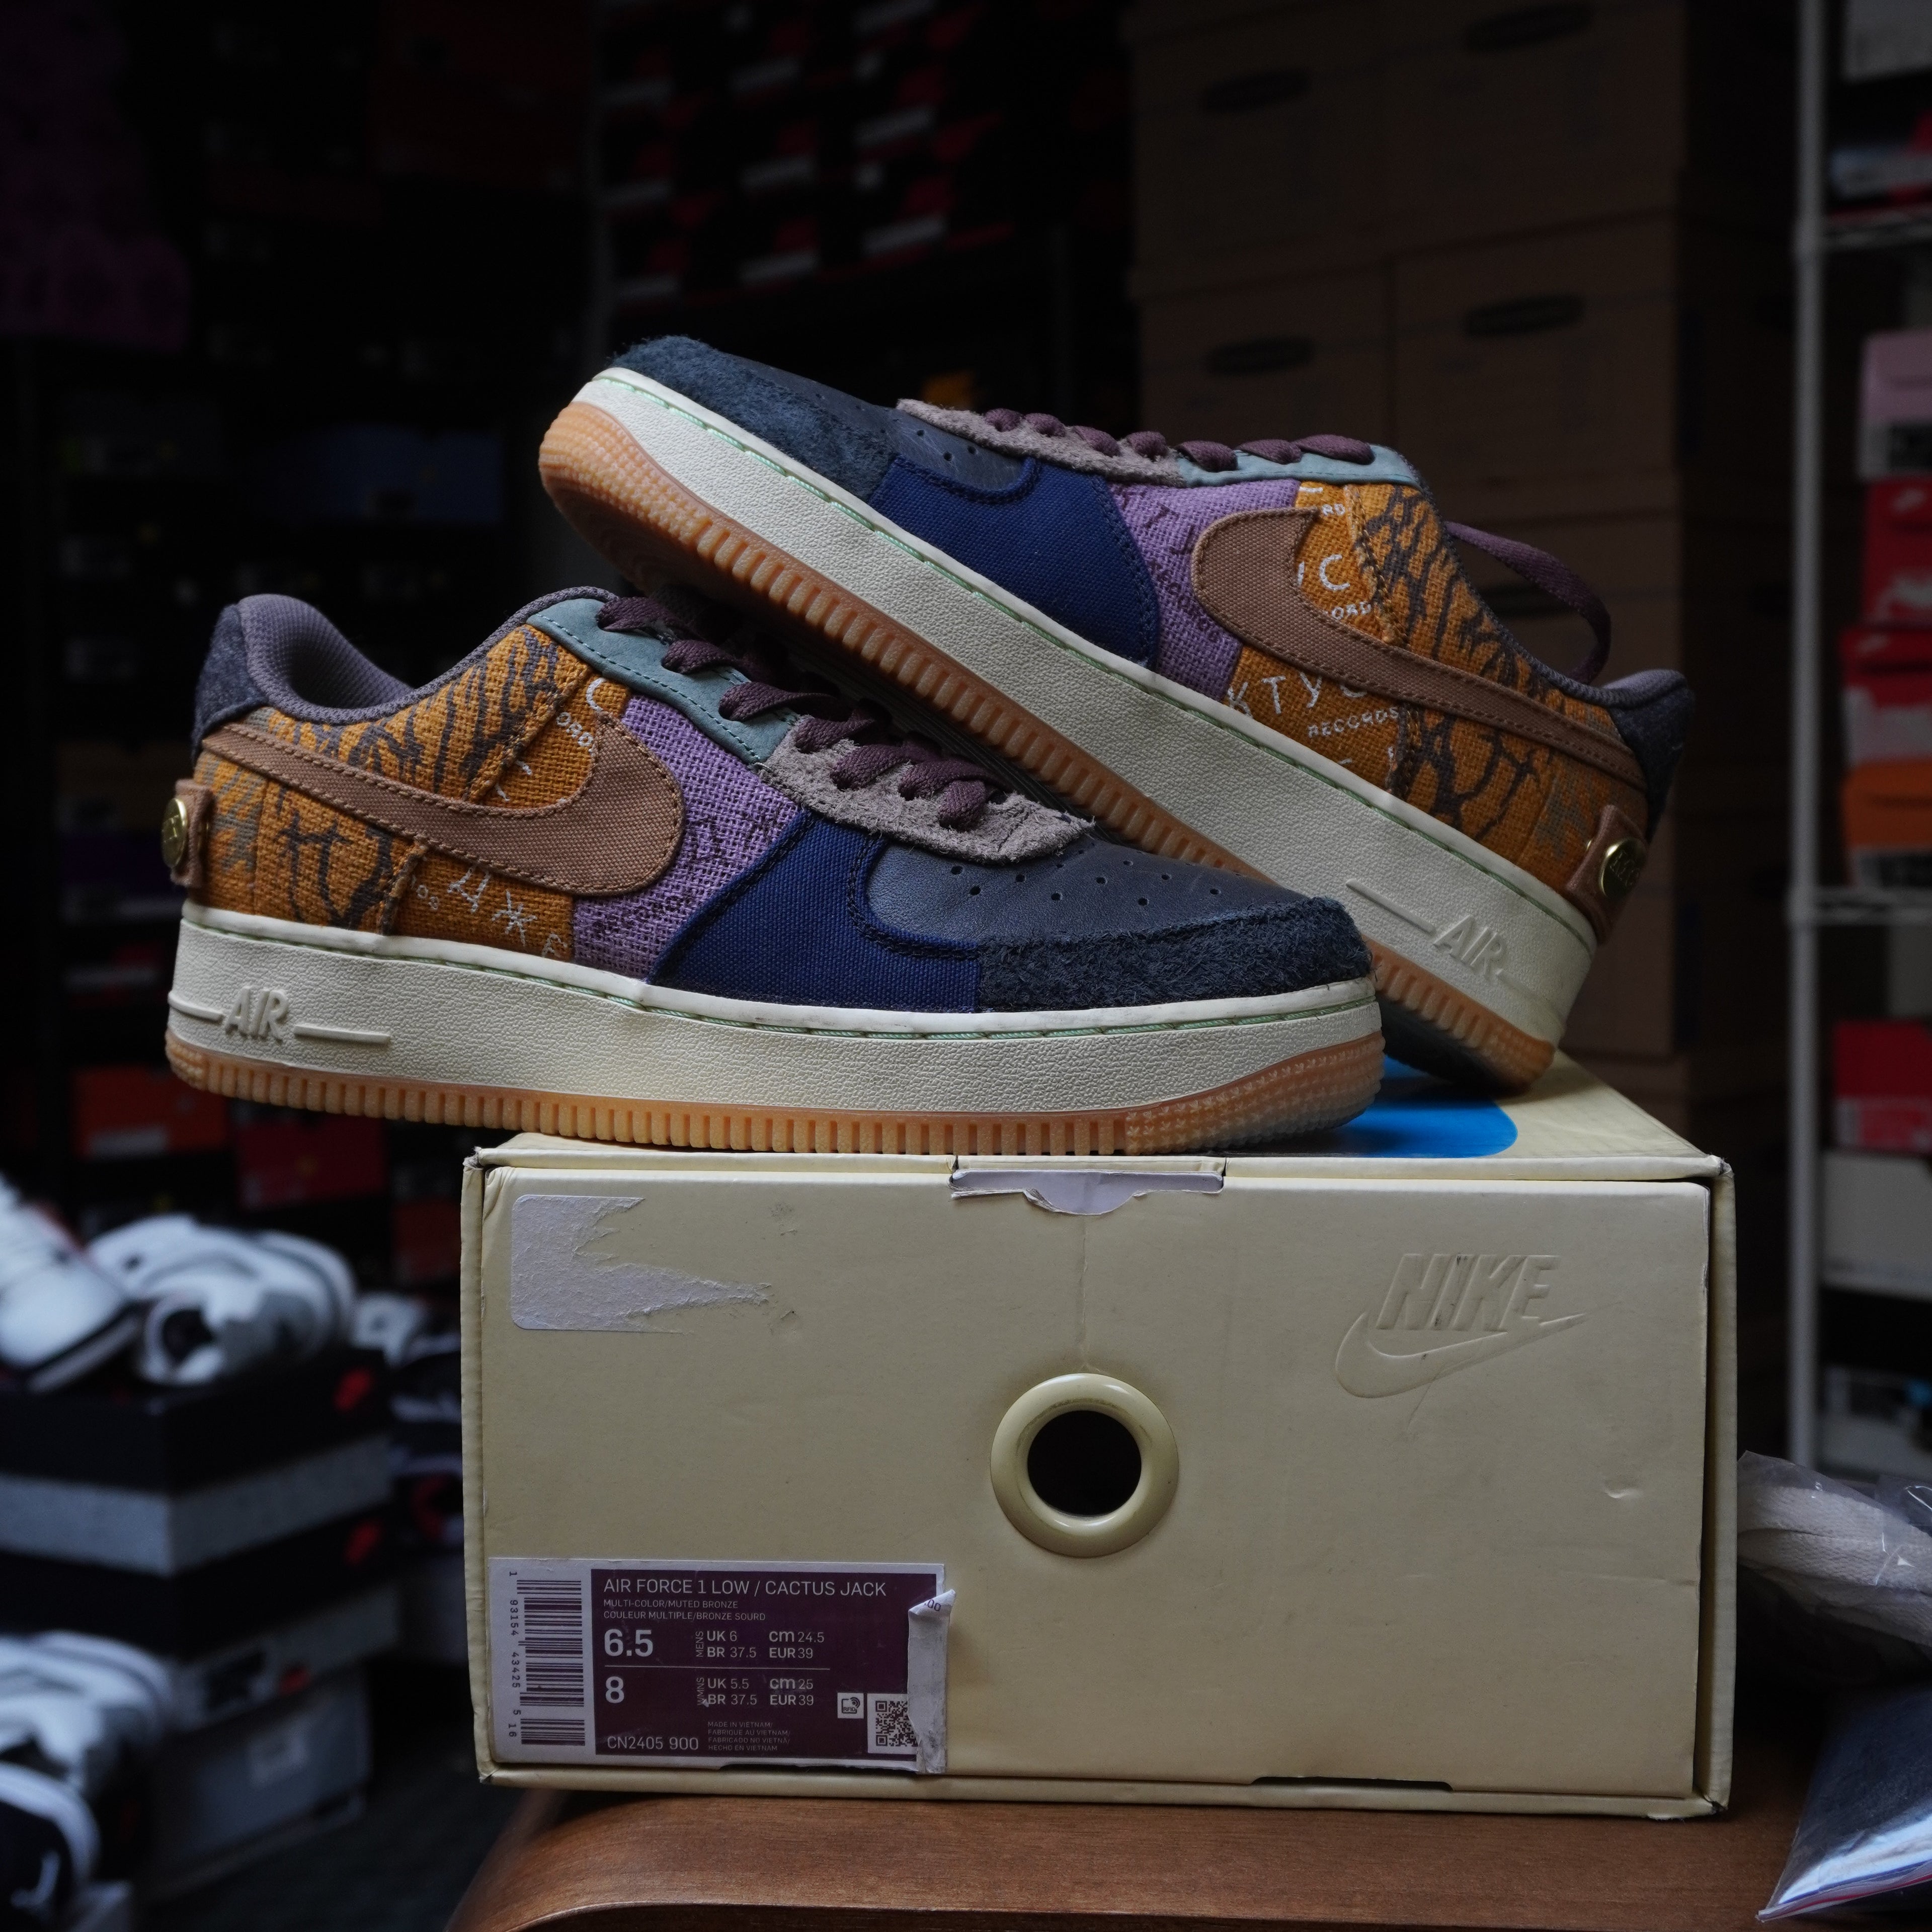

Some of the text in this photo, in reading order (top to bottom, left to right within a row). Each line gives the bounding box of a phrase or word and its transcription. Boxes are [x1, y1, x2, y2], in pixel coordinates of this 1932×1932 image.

[1433, 914, 1508, 981] AIR
[224, 985, 290, 1042] AIR
[1375, 1252, 1561, 1332] NIKE
[603, 1578, 887, 1597] AIR FORCE 1 LOW / CACTUS JACK
[603, 1599, 739, 1609] MULTI-COLOR/MUTED BRONZE
[510, 1599, 519, 1636] 93154
[603, 1611, 766, 1621] COULEUR MULTIPLE/BRONZE SOURD
[604, 1628, 654, 1657] 6.5
[706, 1630, 738, 1642] UK 6
[768, 1631, 825, 1643] cm 24.5
[695, 1630, 704, 1658] MENS
[707, 1646, 757, 1658] BR 37.5
[769, 1647, 814, 1659] EUR 39
[511, 1651, 521, 1688] 43425
[605, 1676, 625, 1704] 8
[707, 1677, 749, 1689] UK 5.5
[769, 1678, 814, 1690] cm 25
[696, 1677, 705, 1706] WMNS
[707, 1694, 757, 1706] BR 37.5
[769, 1694, 814, 1706] EUR 39
[508, 1723, 517, 1738] 16
[607, 1736, 699, 1751] CN2405 900
